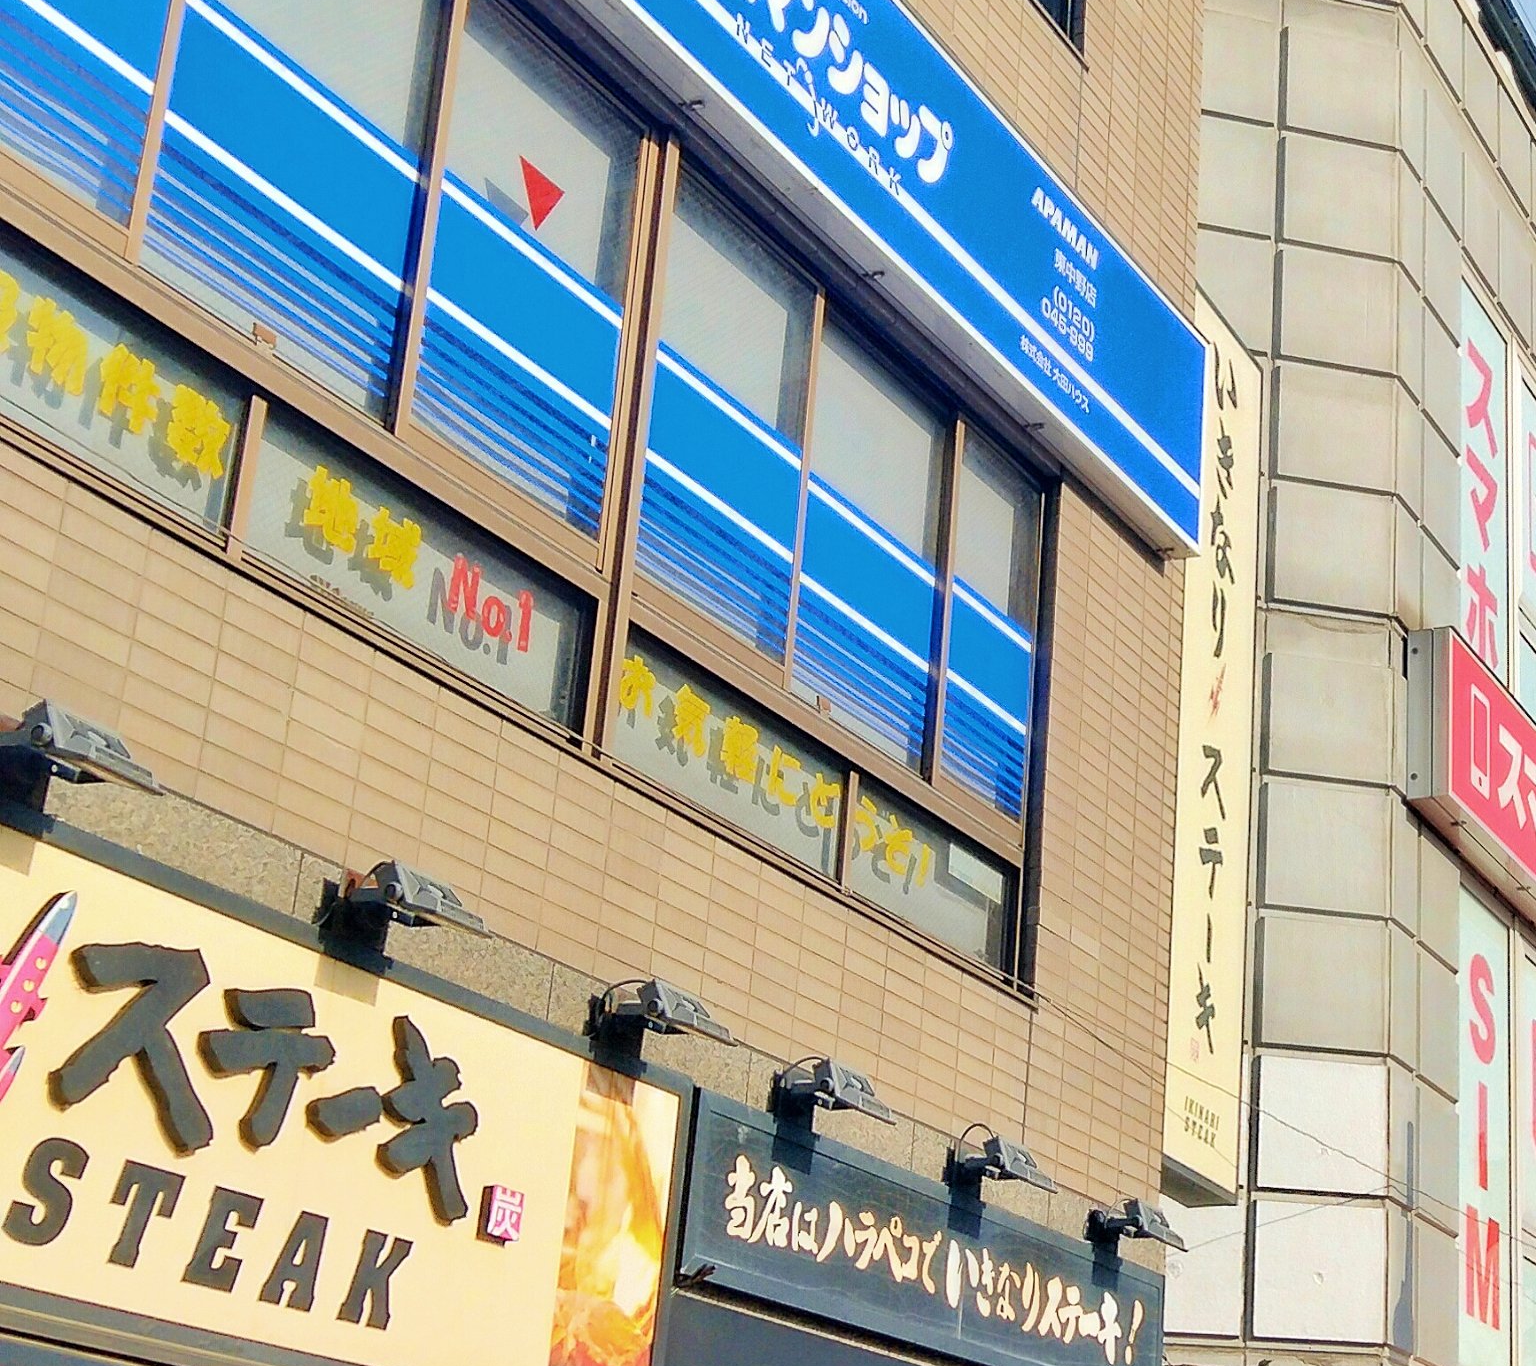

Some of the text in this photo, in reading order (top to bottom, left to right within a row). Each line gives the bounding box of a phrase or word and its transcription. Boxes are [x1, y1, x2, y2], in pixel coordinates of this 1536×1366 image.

[1030, 185, 1099, 271] APAMAN
[1053, 246, 1098, 309] 東中野店
[1052, 285, 1096, 344] (0120)
[1464, 337, 1500, 672] スマホ
[1190, 357, 1241, 1057] いきなり ステーキ
[48, 941, 479, 1227] ステーキ
[1183, 1095, 1221, 1132] IKINARI
[1183, 1116, 1217, 1149] STEAK
[1465, 952, 1501, 1333] SIM
[1, 1137, 413, 1330] STEAK
